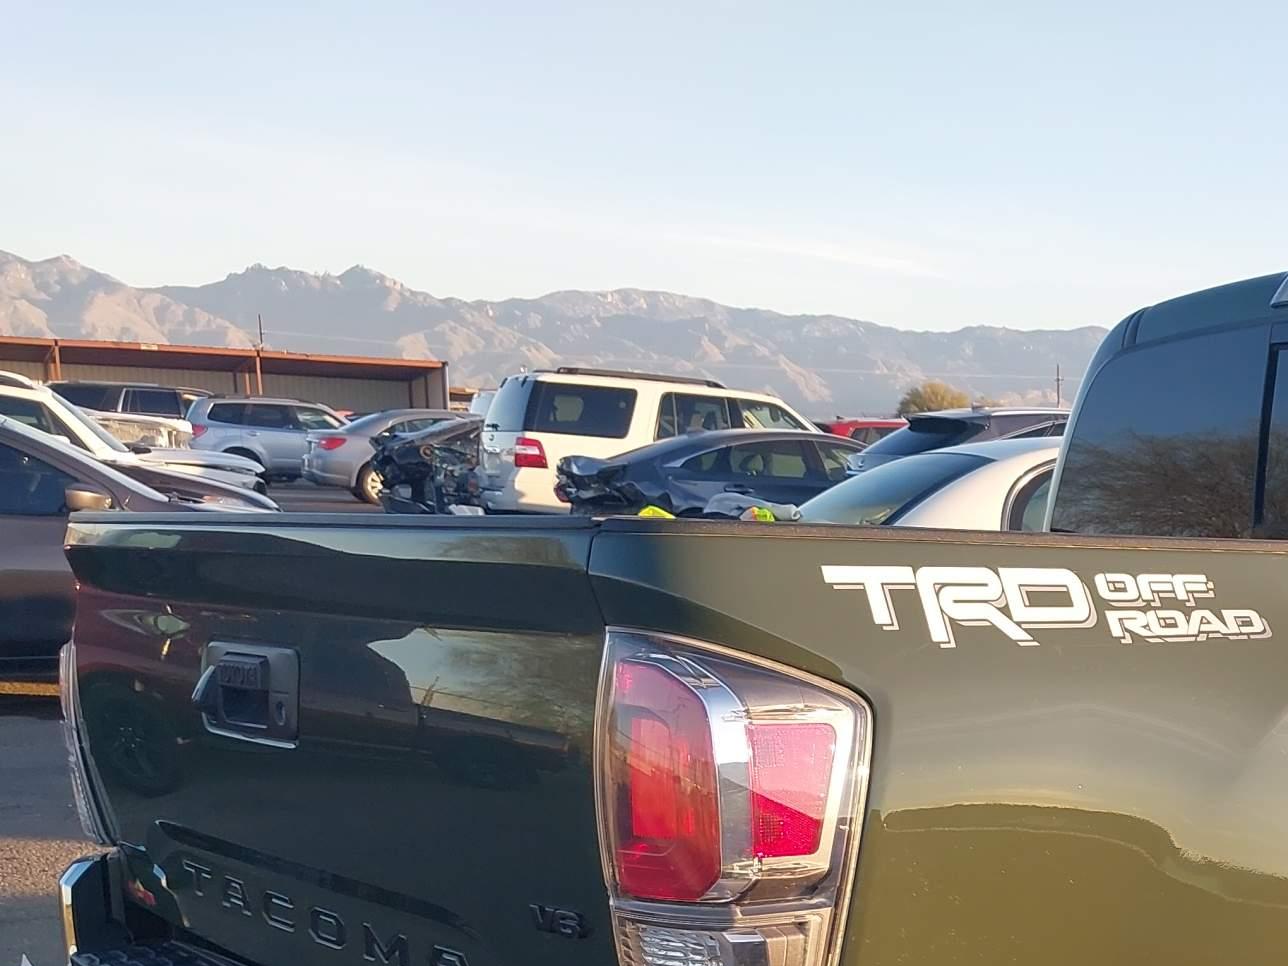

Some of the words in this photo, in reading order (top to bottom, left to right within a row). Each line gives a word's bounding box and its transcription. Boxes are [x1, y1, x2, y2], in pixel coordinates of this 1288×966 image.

[820, 565, 1098, 649] TRD
[1093, 572, 1216, 608] OFF
[1104, 609, 1273, 645] ROAD
